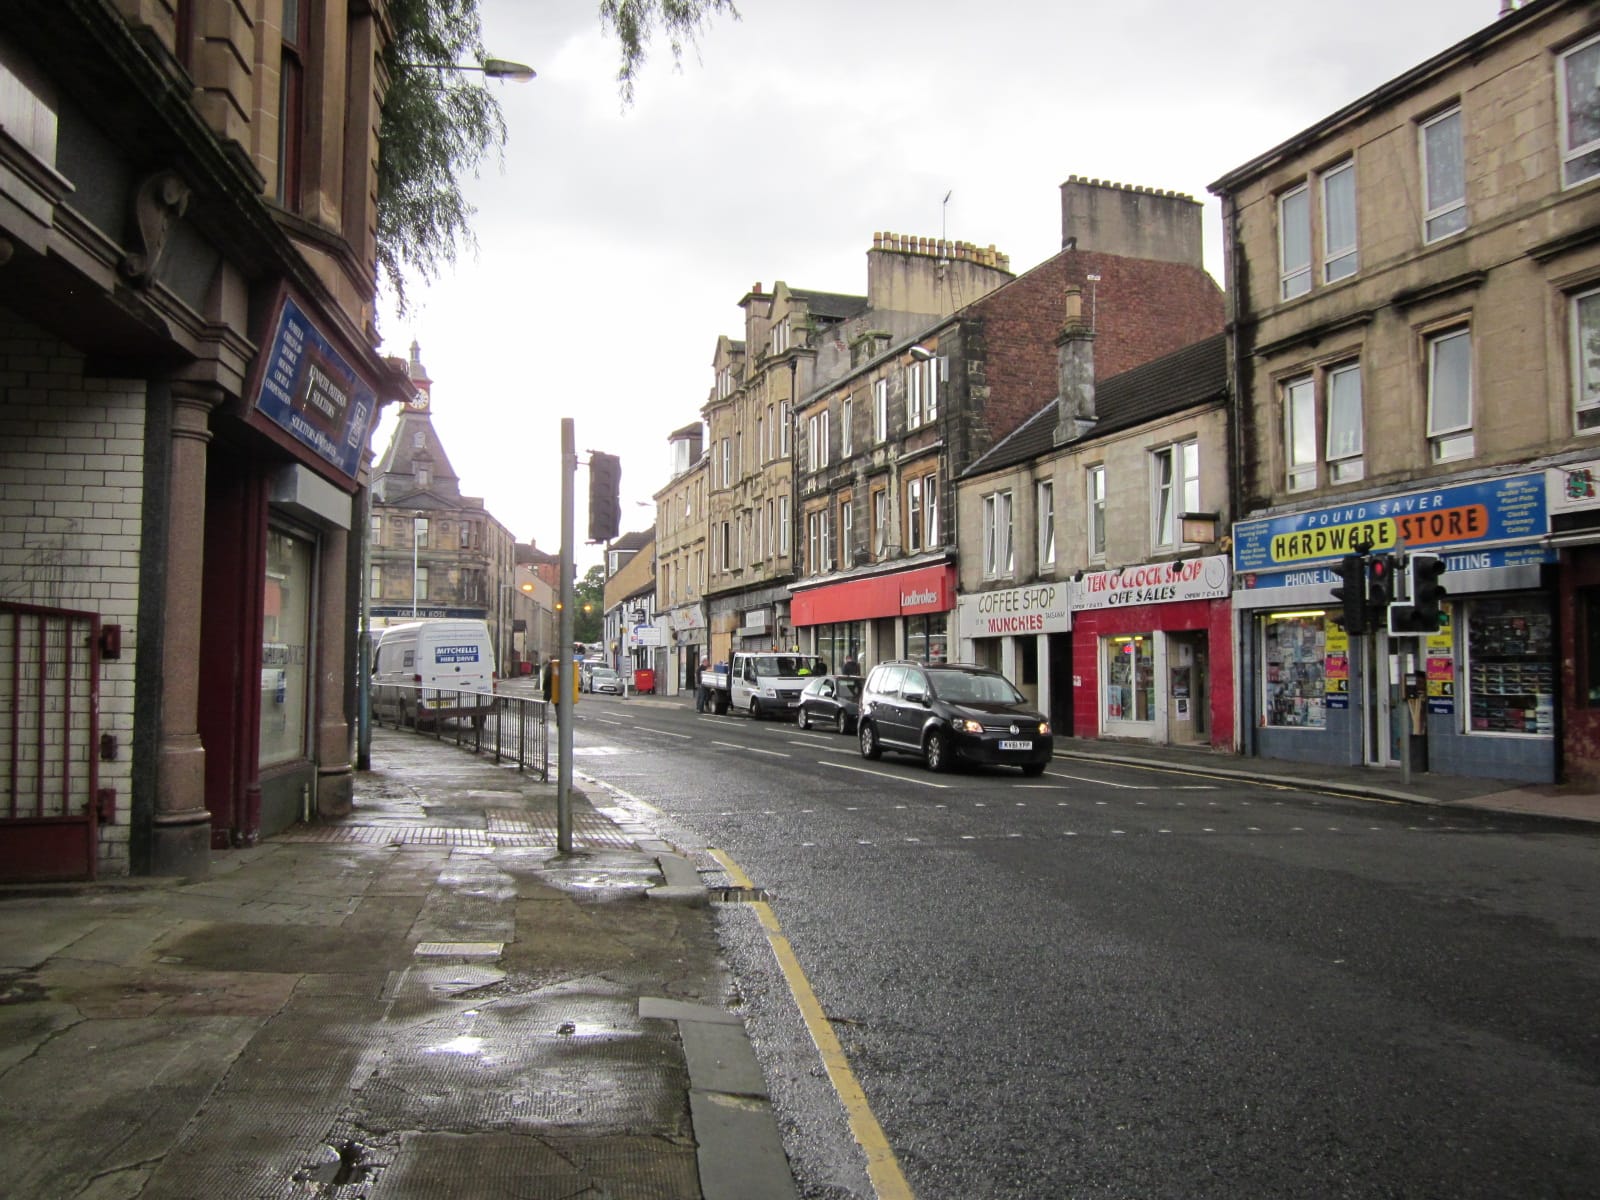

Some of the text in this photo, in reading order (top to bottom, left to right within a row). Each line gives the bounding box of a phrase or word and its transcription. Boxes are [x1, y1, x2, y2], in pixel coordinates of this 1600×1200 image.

[1308, 495, 1443, 527] POUND SAVER
[1275, 509, 1479, 558] HARDWARE STORE
[1087, 573, 1106, 592] TEN
[1166, 560, 1201, 583] SHOP
[1285, 570, 1319, 587] PHONE
[901, 588, 937, 607] Ladbrokes
[978, 587, 1055, 613] COFFEE SHOP
[1108, 586, 1176, 605] OFF SALES
[988, 614, 1043, 633] MUNCHIES
[436, 646, 478, 655] MITCHELLS
